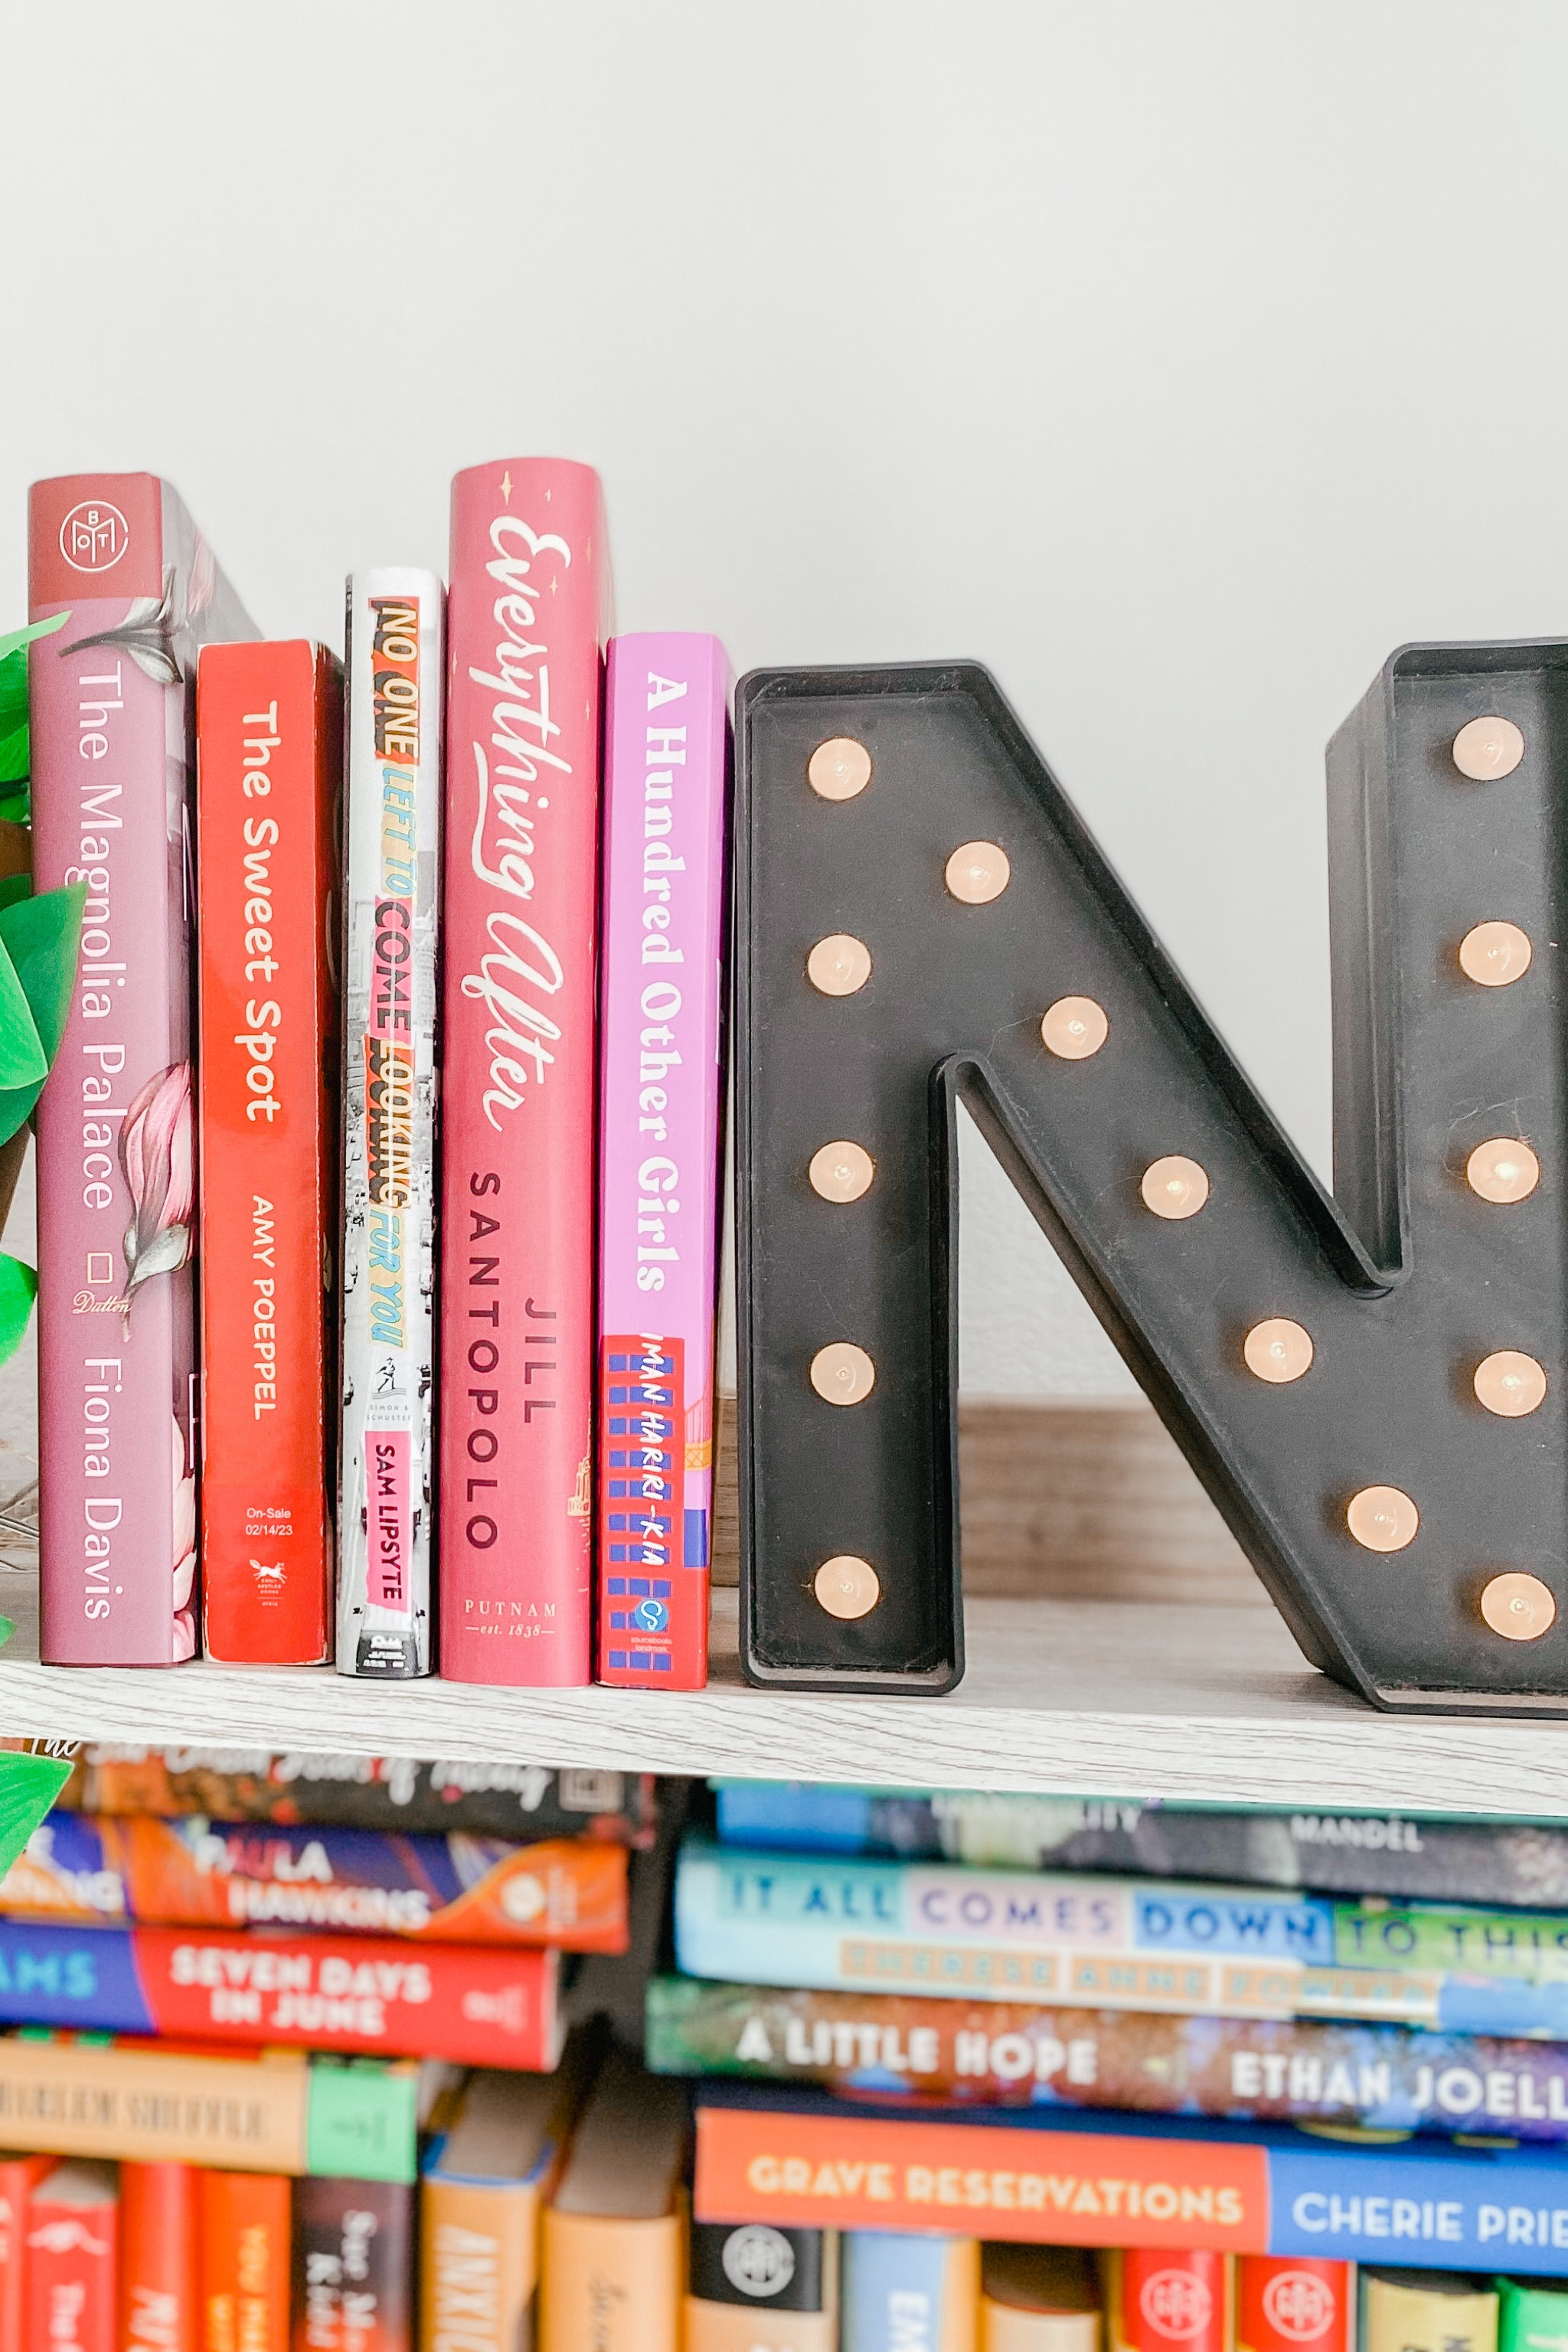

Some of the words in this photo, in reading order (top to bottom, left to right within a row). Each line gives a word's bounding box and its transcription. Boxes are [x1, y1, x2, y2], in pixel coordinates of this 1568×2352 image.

[382, 607, 417, 662] NO
[78, 661, 124, 760] The
[384, 678, 418, 759] ONE
[469, 515, 572, 902] Everything
[646, 671, 688, 712] A
[242, 700, 282, 799] The
[383, 767, 416, 851] LEFT
[641, 726, 688, 965] Hundred
[64, 783, 127, 1019] Magnolia
[243, 816, 279, 984] Sweet
[385, 857, 417, 896] TO
[374, 901, 411, 1031] COME
[234, 998, 283, 1124] Spot
[461, 912, 564, 1132] After
[639, 981, 683, 1143] Other
[82, 1043, 128, 1210] Palace
[378, 1039, 414, 1209] LOOKING
[251, 1194, 275, 1269] AMY
[370, 1210, 400, 1272] FOR
[637, 1154, 681, 1292] Girls
[72, 1290, 133, 1315] Dutton
[371, 1282, 403, 1348] YOU
[252, 1278, 278, 1421] POEPPEL
[466, 1171, 501, 1550] SANTOPOLO
[524, 1298, 557, 1424] JILL
[639, 1332, 666, 1403] IMAN
[83, 1357, 122, 1477] Fiona
[375, 1444, 396, 1496] SAM
[639, 1410, 666, 1566] HARIRI-KIA
[245, 1524, 293, 1536] 02/14/23
[247, 1508, 292, 1519] On-Sale
[378, 1506, 403, 1601] LIPSYTE
[83, 1497, 125, 1620] Davis
[465, 1599, 557, 1618] PUTNAM
[196, 1834, 334, 1883] PAULA
[229, 1879, 431, 1929] HAWKINS
[732, 1872, 773, 1910] IT
[804, 1883, 899, 1922] ALL
[920, 1887, 1116, 1937] COMES
[1142, 1903, 1319, 1949] DOWN
[1347, 1916, 1419, 1955] TO
[170, 1945, 310, 1990] SEVEN
[319, 1957, 432, 2004] DAYS
[211, 1988, 261, 2024] IN
[271, 1991, 386, 2035] JUNE
[736, 2015, 774, 2063] A
[785, 2017, 940, 2074] LITTLE
[954, 2029, 1099, 2086] HOPE
[1231, 2050, 1393, 2107] ETHAN
[748, 2154, 893, 2201] GRAVE
[906, 2165, 1244, 2225] RESERVATIONS
[1293, 2191, 1465, 2243] CHERIE
